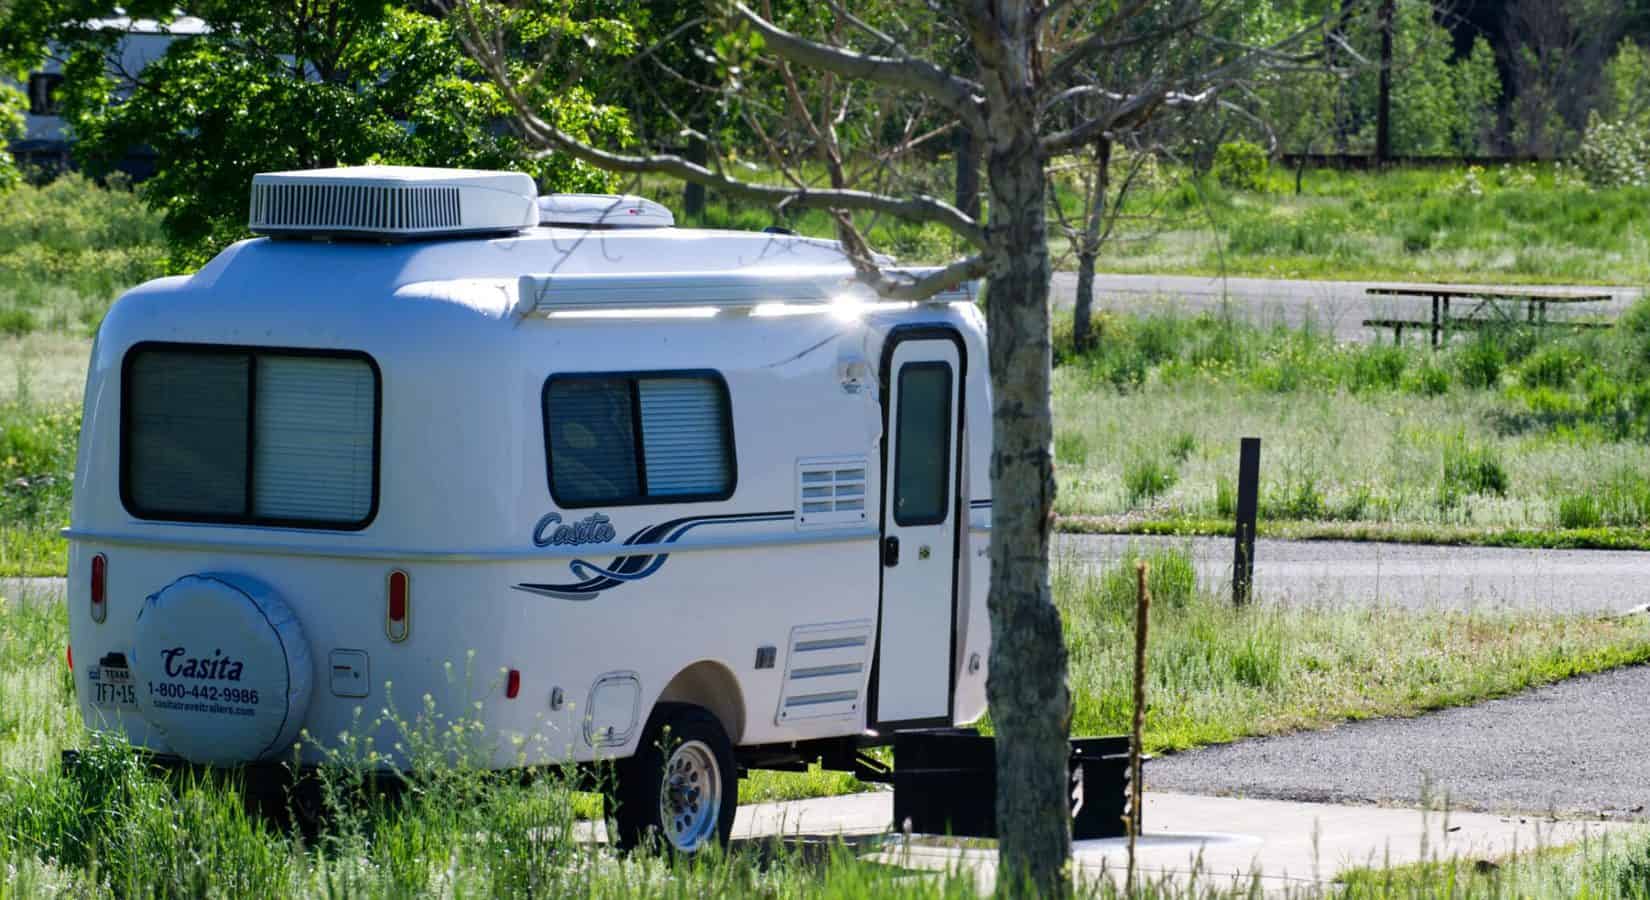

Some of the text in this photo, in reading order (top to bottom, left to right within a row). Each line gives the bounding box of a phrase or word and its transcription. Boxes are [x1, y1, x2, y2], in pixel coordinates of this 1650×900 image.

[533, 511, 616, 547] Casita
[105, 669, 129, 679] TEXAS
[161, 647, 244, 681] Casita
[148, 681, 259, 705] 1-800-442-9986
